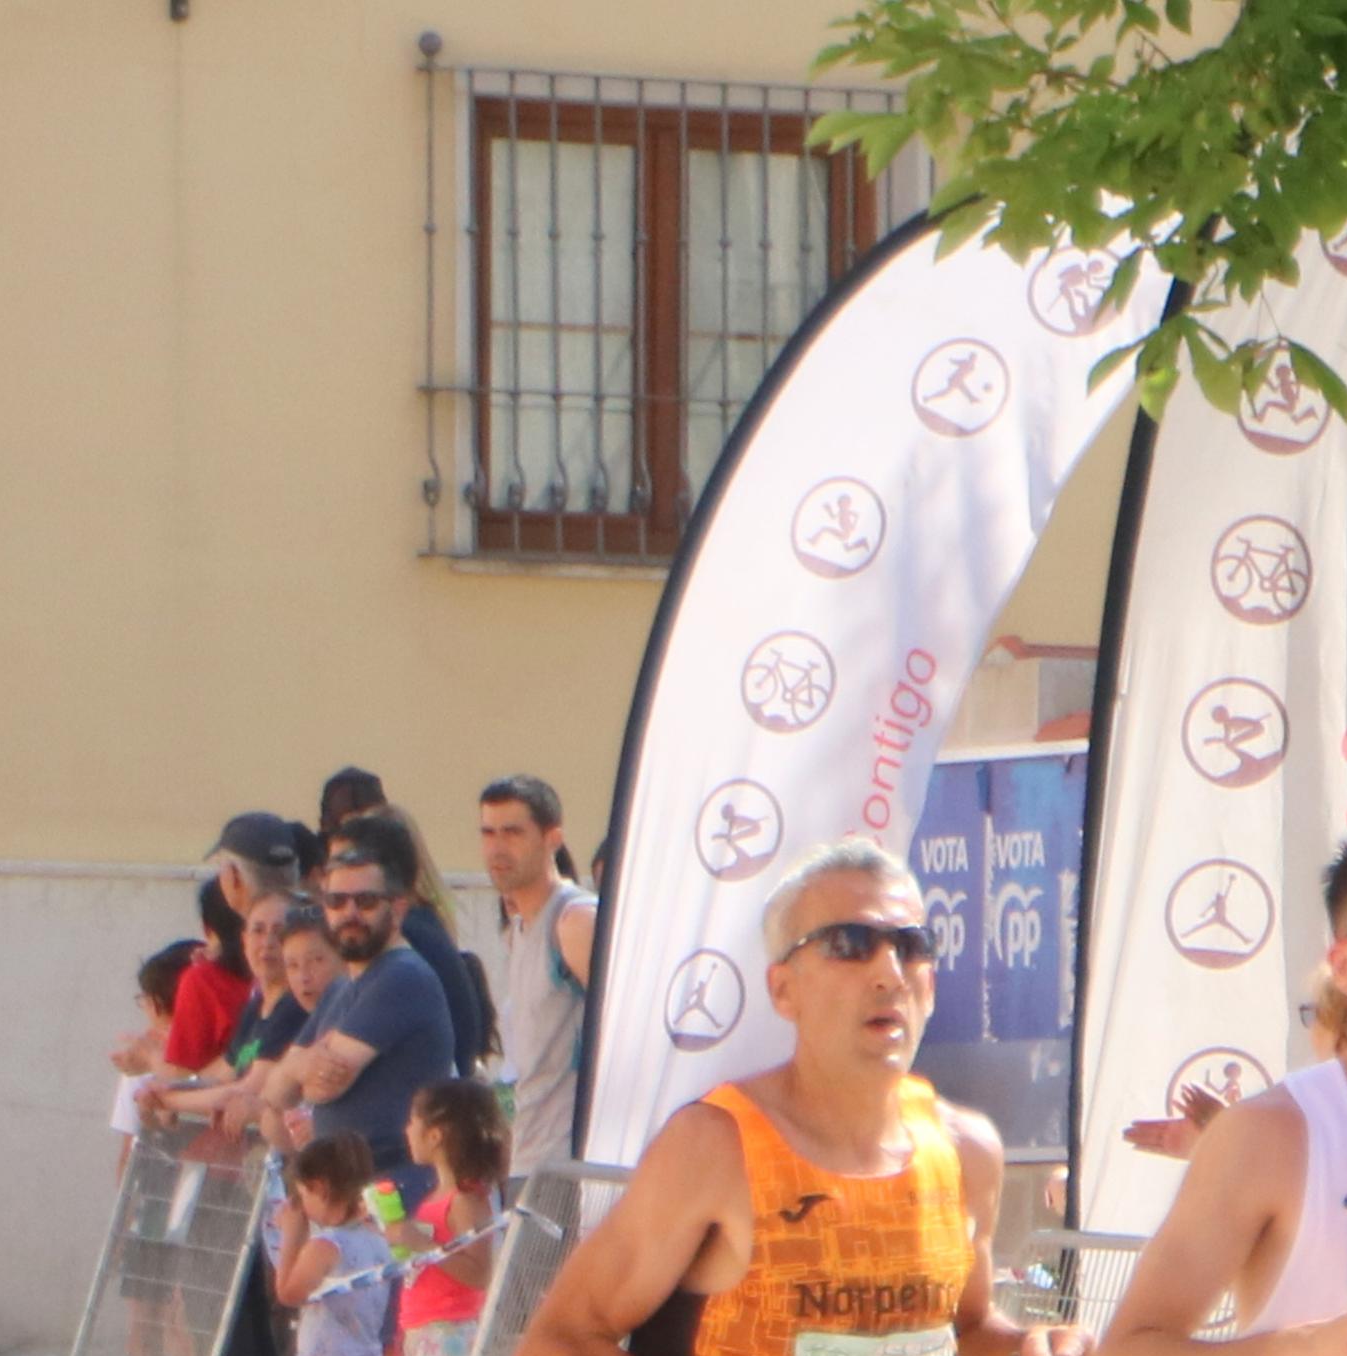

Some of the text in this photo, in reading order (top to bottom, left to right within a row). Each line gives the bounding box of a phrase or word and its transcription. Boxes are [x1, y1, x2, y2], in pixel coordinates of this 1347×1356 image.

[844, 648, 937, 852] ontigo
[921, 837, 968, 874] VOTA
[997, 832, 1045, 870] VOTA
